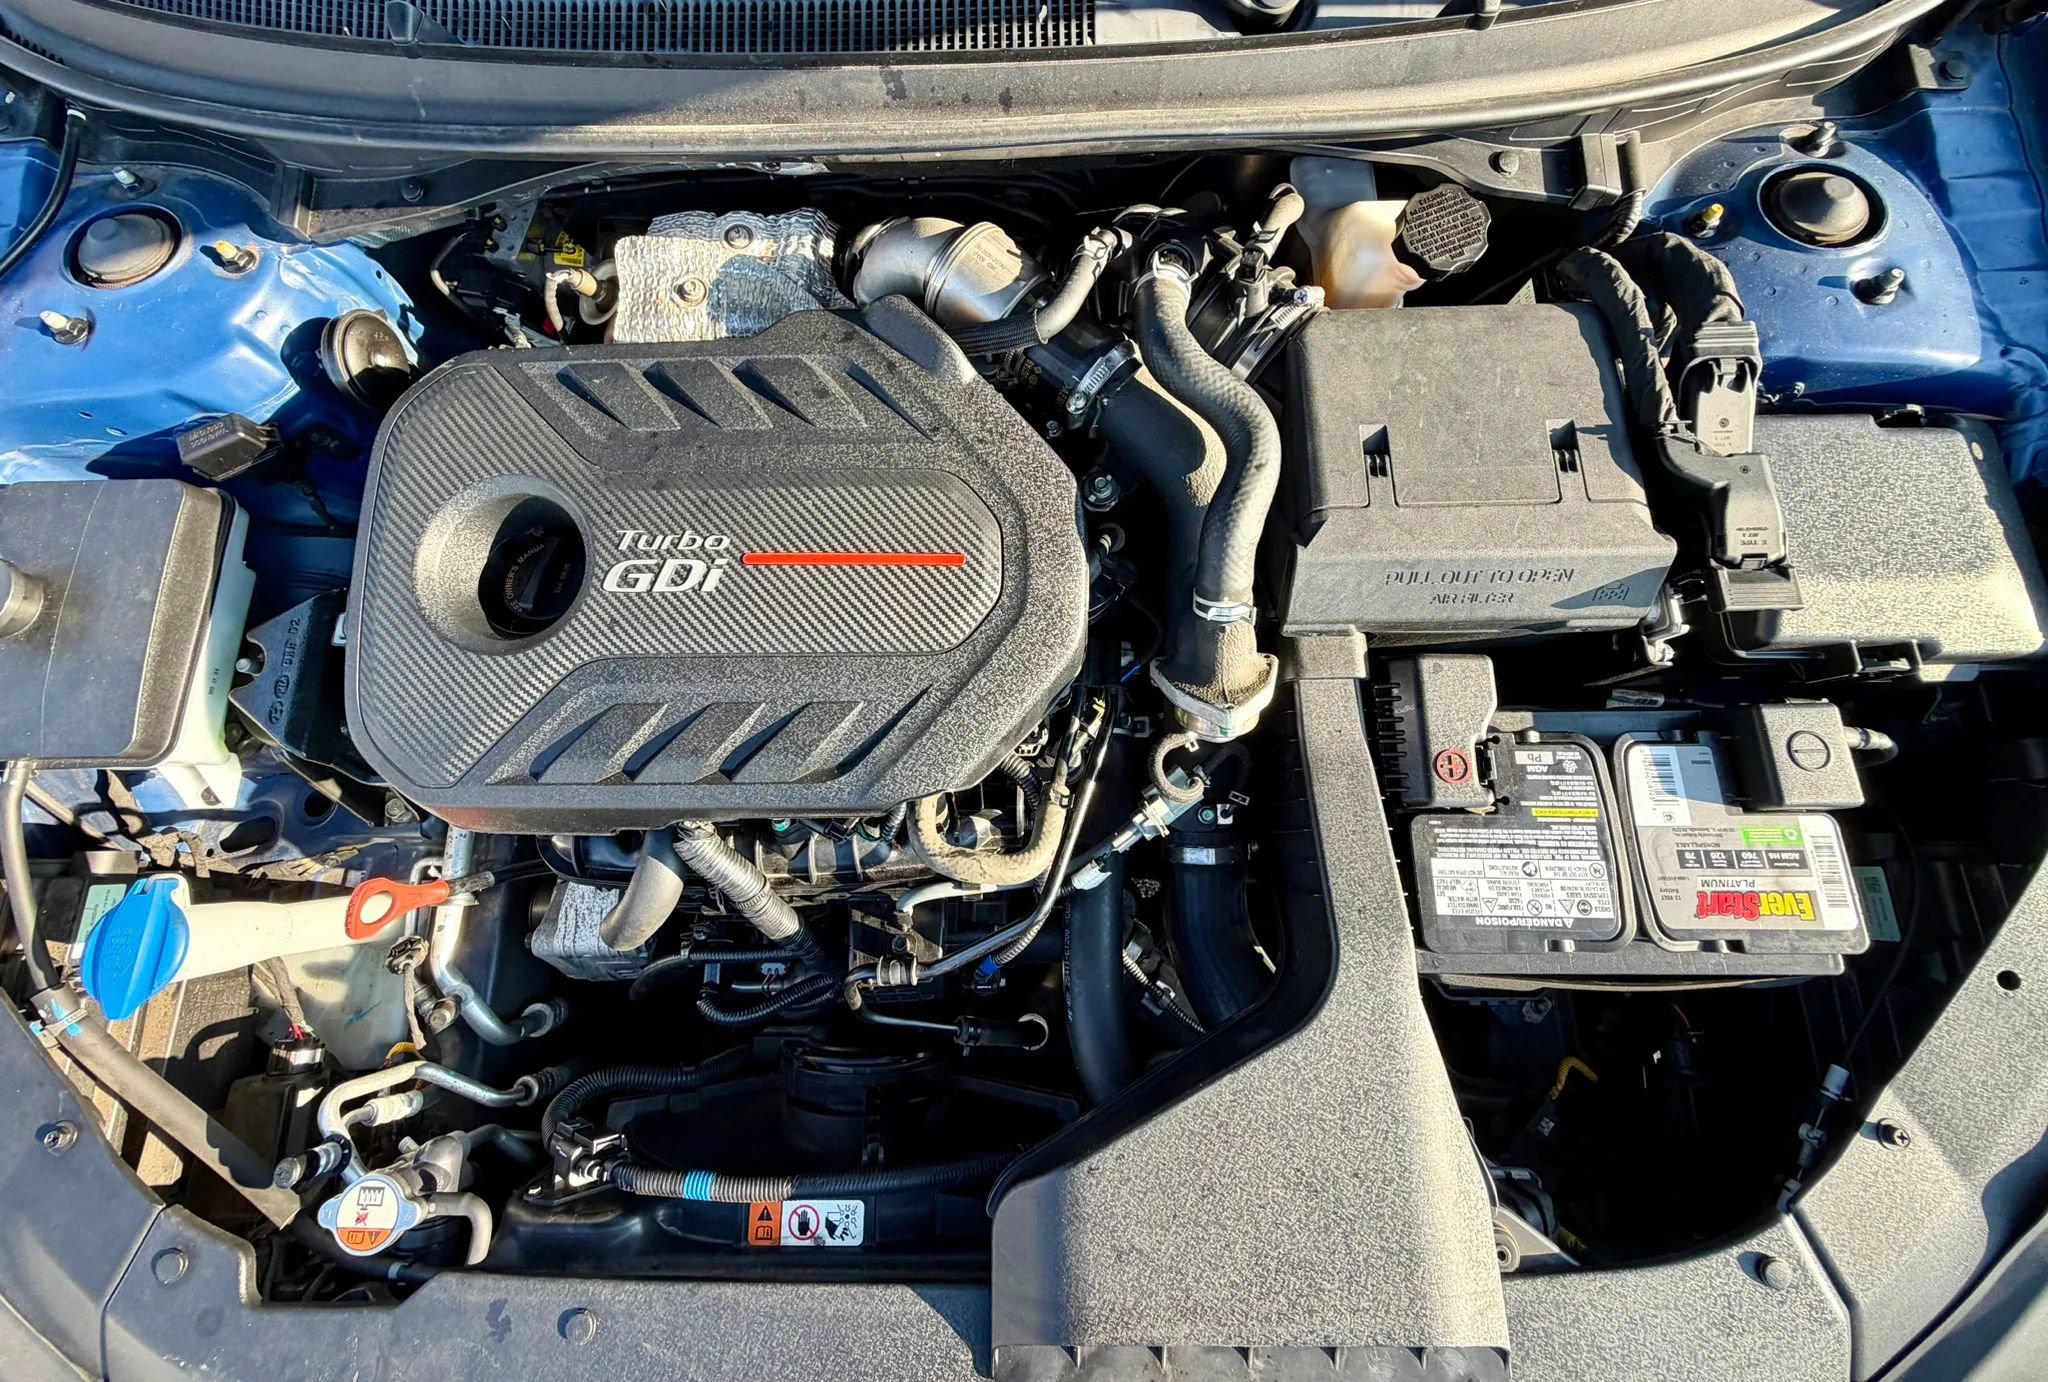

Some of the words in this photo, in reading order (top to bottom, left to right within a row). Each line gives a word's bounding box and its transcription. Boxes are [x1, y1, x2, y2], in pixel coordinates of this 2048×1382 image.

[616, 530, 731, 550] Turbo
[602, 558, 729, 592] GDi
[1386, 570, 1435, 586] PULL
[1440, 569, 1484, 585] OUT
[1489, 569, 1515, 584] TO
[1517, 568, 1576, 583] OPEN
[1429, 593, 1457, 605] AIR
[1460, 592, 1515, 604] FILTER
[1527, 753, 1542, 763] Pb
[1526, 765, 1549, 773] AGM
[1684, 851, 1697, 859] 70
[1710, 851, 1726, 859] 120
[1741, 851, 1761, 859] 760
[1768, 852, 1780, 860] H6
[1780, 852, 1800, 860] AGM
[1700, 879, 1756, 888] PLATINUM
[1696, 891, 1816, 922] EverStart
[1475, 917, 1564, 927] DANGER/POISON
